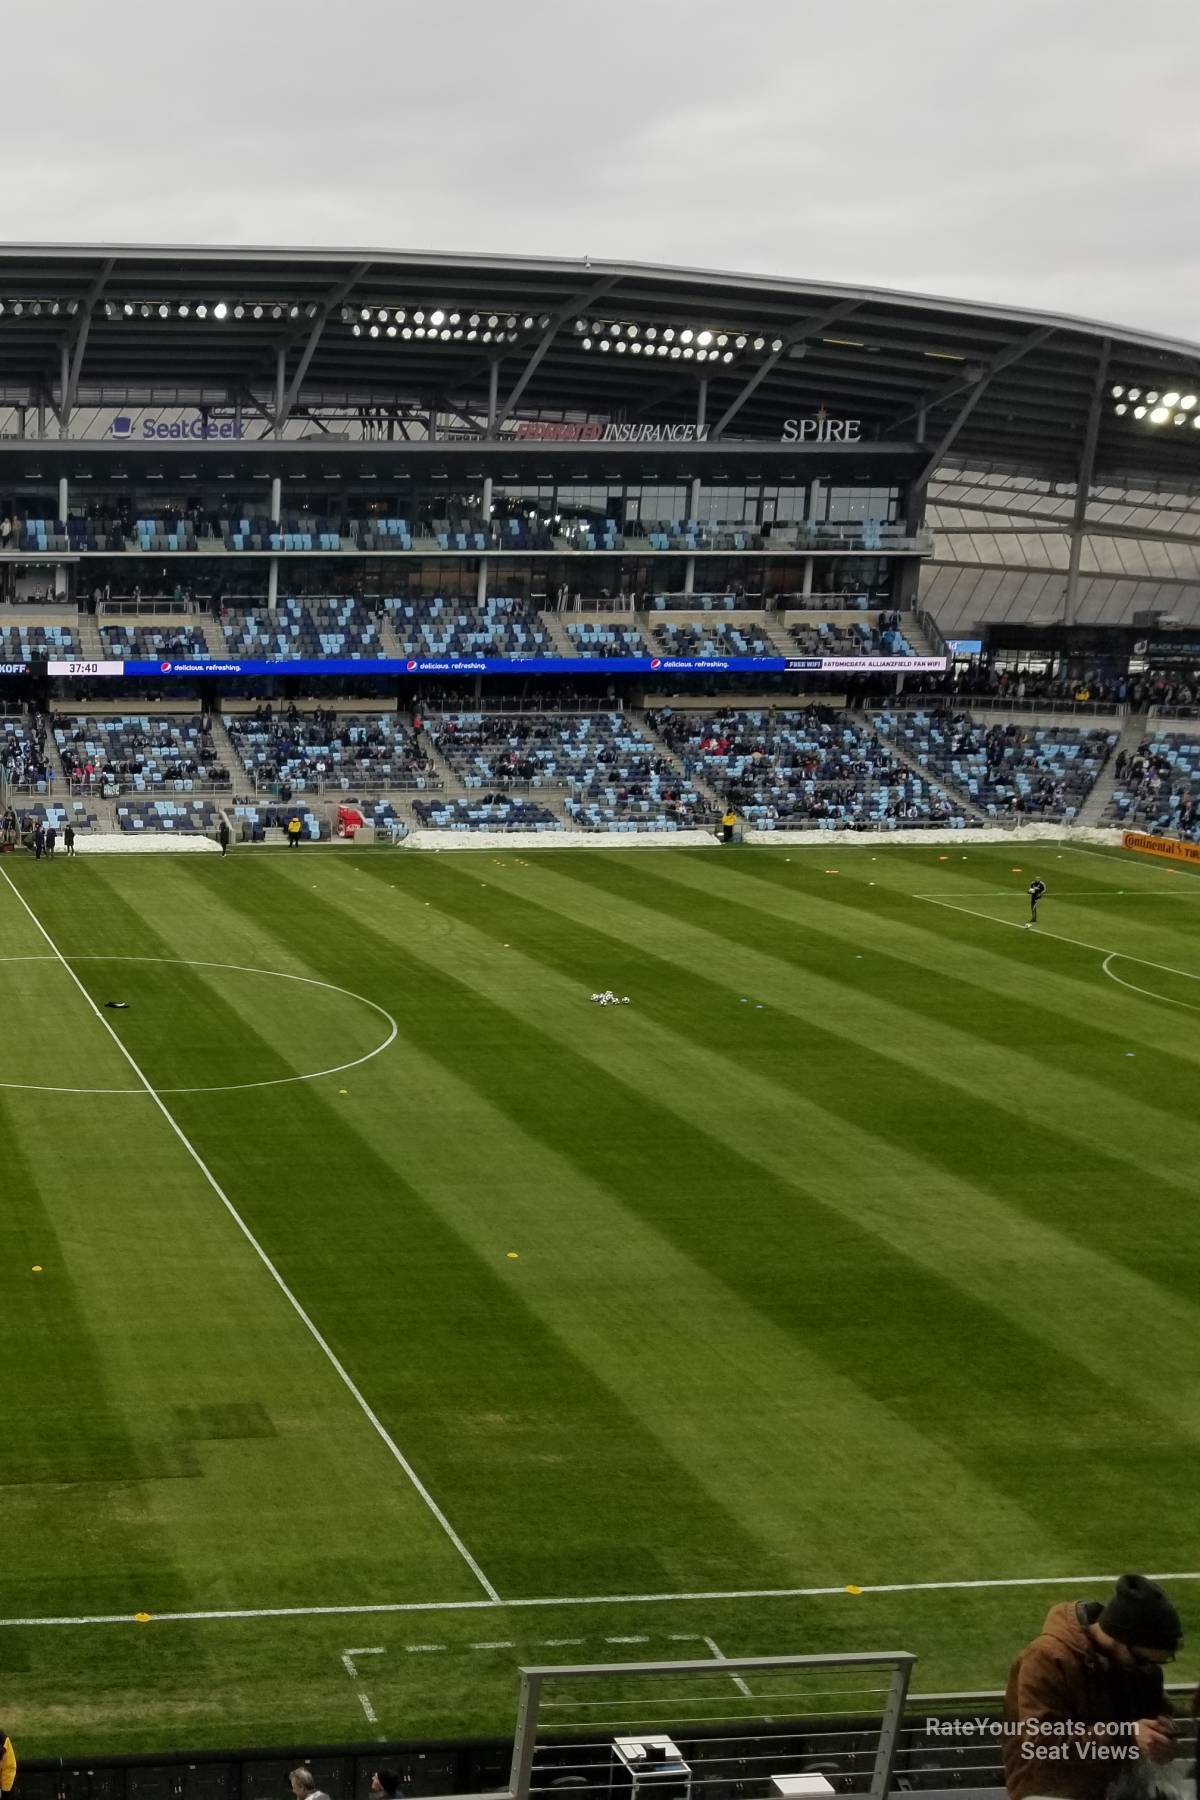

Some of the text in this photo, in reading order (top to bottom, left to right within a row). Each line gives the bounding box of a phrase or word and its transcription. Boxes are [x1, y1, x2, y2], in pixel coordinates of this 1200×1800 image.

[143, 419, 244, 438] SeatGeek
[603, 423, 696, 441] INSURANCE
[781, 419, 861, 442] SPIRE
[69, 663, 98, 673] 37:40
[451, 662, 487, 670] refreshing.
[694, 661, 730, 669] refreshing.
[1125, 834, 1174, 854] Continental
